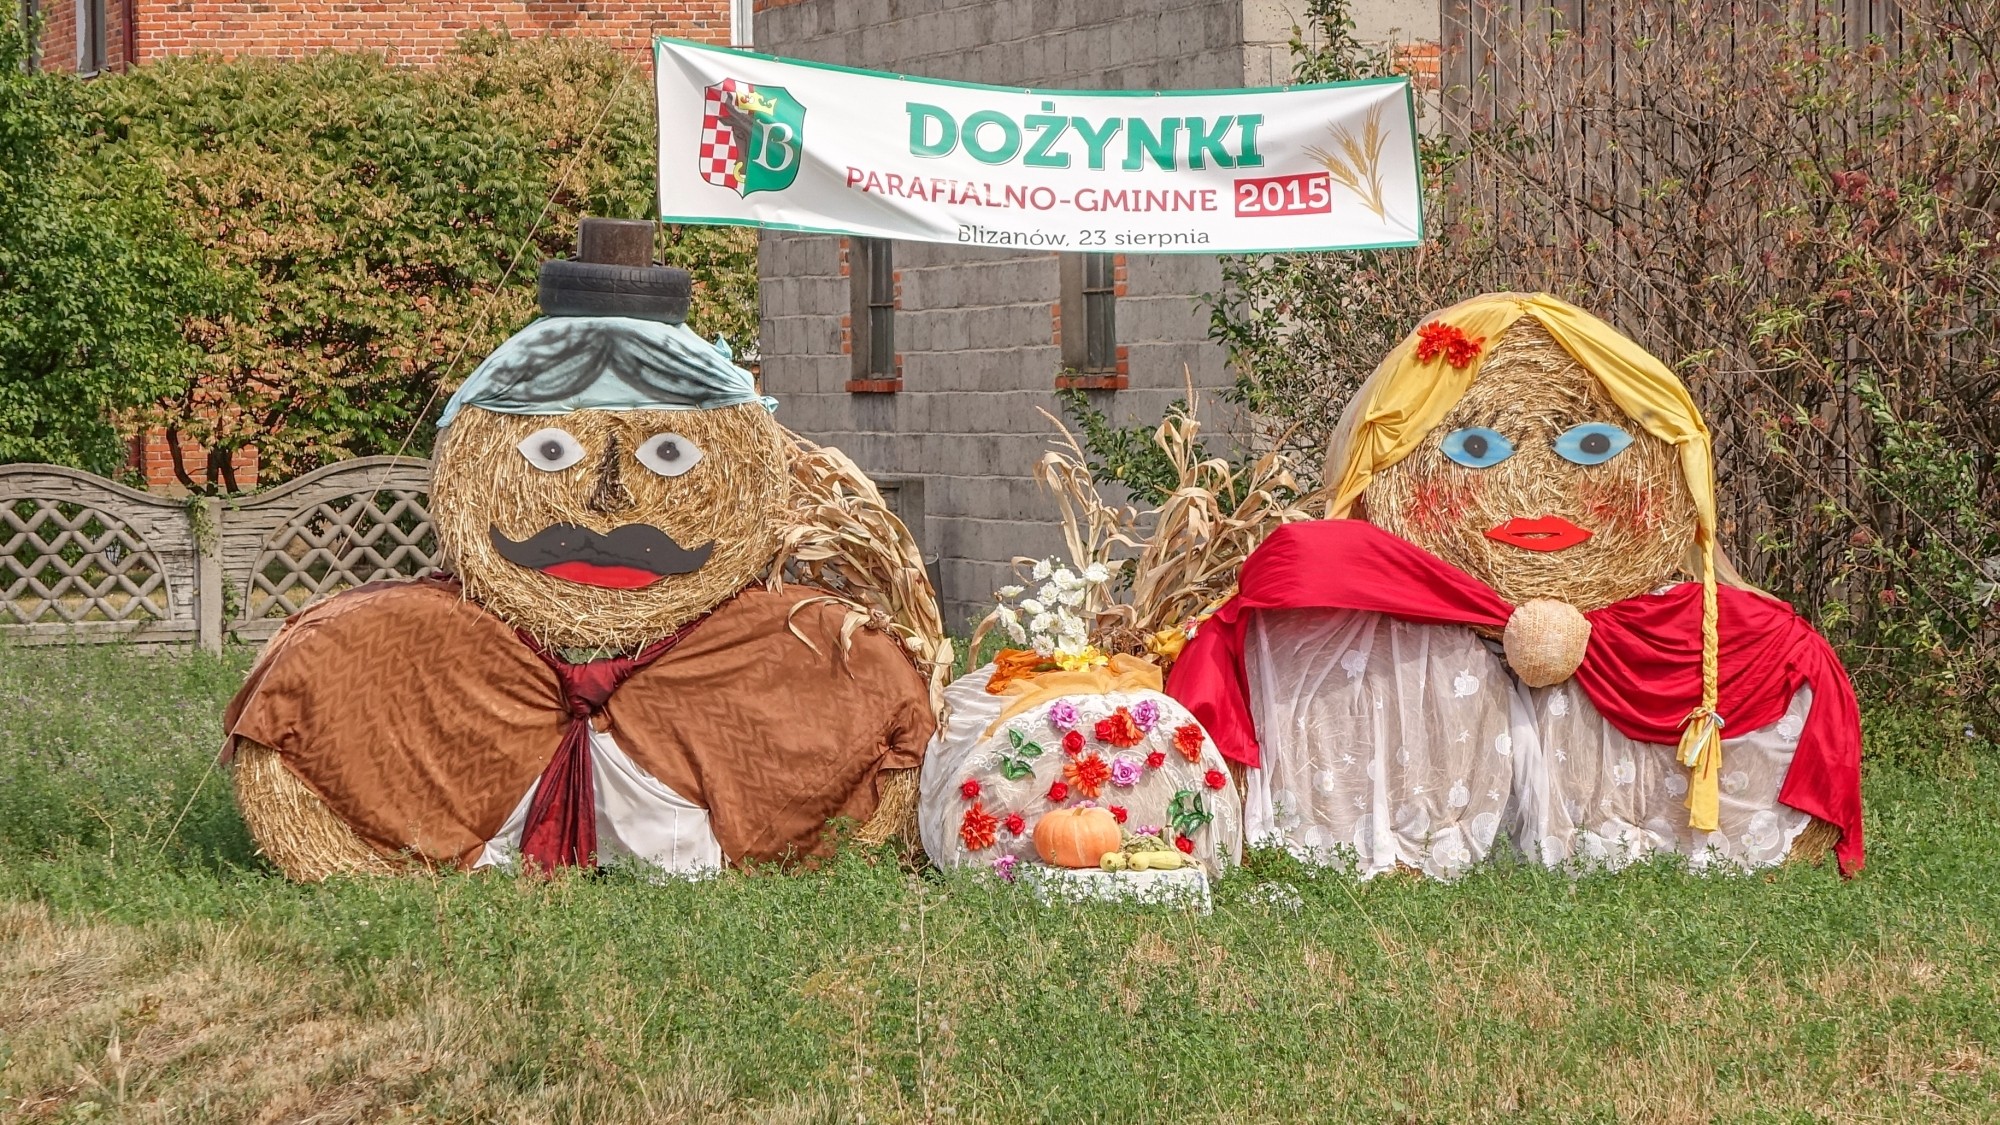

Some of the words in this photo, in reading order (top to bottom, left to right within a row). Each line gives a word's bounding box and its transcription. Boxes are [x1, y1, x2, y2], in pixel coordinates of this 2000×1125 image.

[752, 118, 794, 171] B
[906, 101, 1265, 172] DOŻYNKI
[846, 166, 1218, 212] PARAFIALNO-GMINNE
[1238, 177, 1330, 213] 2015
[958, 224, 1071, 248] Blizanów,
[1079, 229, 1107, 246] 23
[1114, 228, 1210, 248] sierpnia
